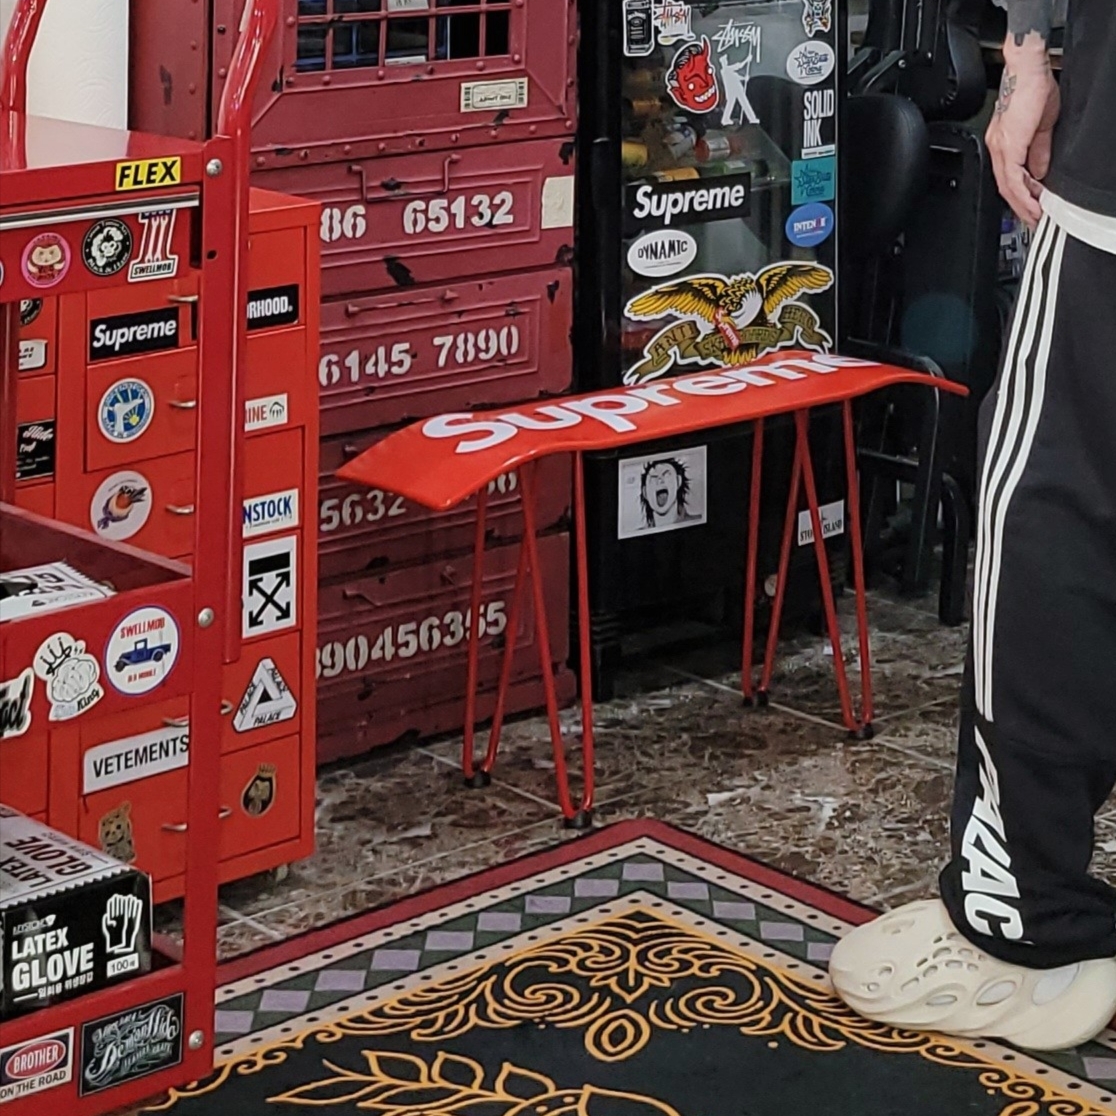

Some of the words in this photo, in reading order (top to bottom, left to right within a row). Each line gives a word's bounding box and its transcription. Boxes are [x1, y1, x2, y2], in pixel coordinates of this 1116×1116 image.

[803, 89, 834, 120] SOLID
[803, 118, 823, 148] INK
[118, 160, 179, 187] FLEX
[319, 205, 367, 242] 86
[403, 191, 514, 234] 65132
[633, 184, 745, 225] Supreme
[637, 240, 688, 259] DYNAMIC
[134, 262, 172, 275] SWELLMOB
[246, 295, 293, 320] RHOOD.
[92, 318, 177, 350] Supreme
[652, 323, 696, 357] ANTI
[318, 342, 412, 386] 6145
[432, 324, 519, 367] 7890
[422, 353, 884, 454] Supreme
[120, 617, 165, 639] SWELLMOB
[253, 711, 282, 726] PALACE
[93, 734, 189, 777] VETEMENTS
[0, 856, 54, 888] LATEX
[4, 836, 93, 877] GLOVE
[12, 926, 69, 961] LATEX
[12, 942, 94, 992] GLOVE
[13, 1046, 59, 1073] BROTHER
[0, 1085, 15, 1099] ON
[16, 1078, 36, 1093] THE
[38, 1070, 67, 1088] ROAD
